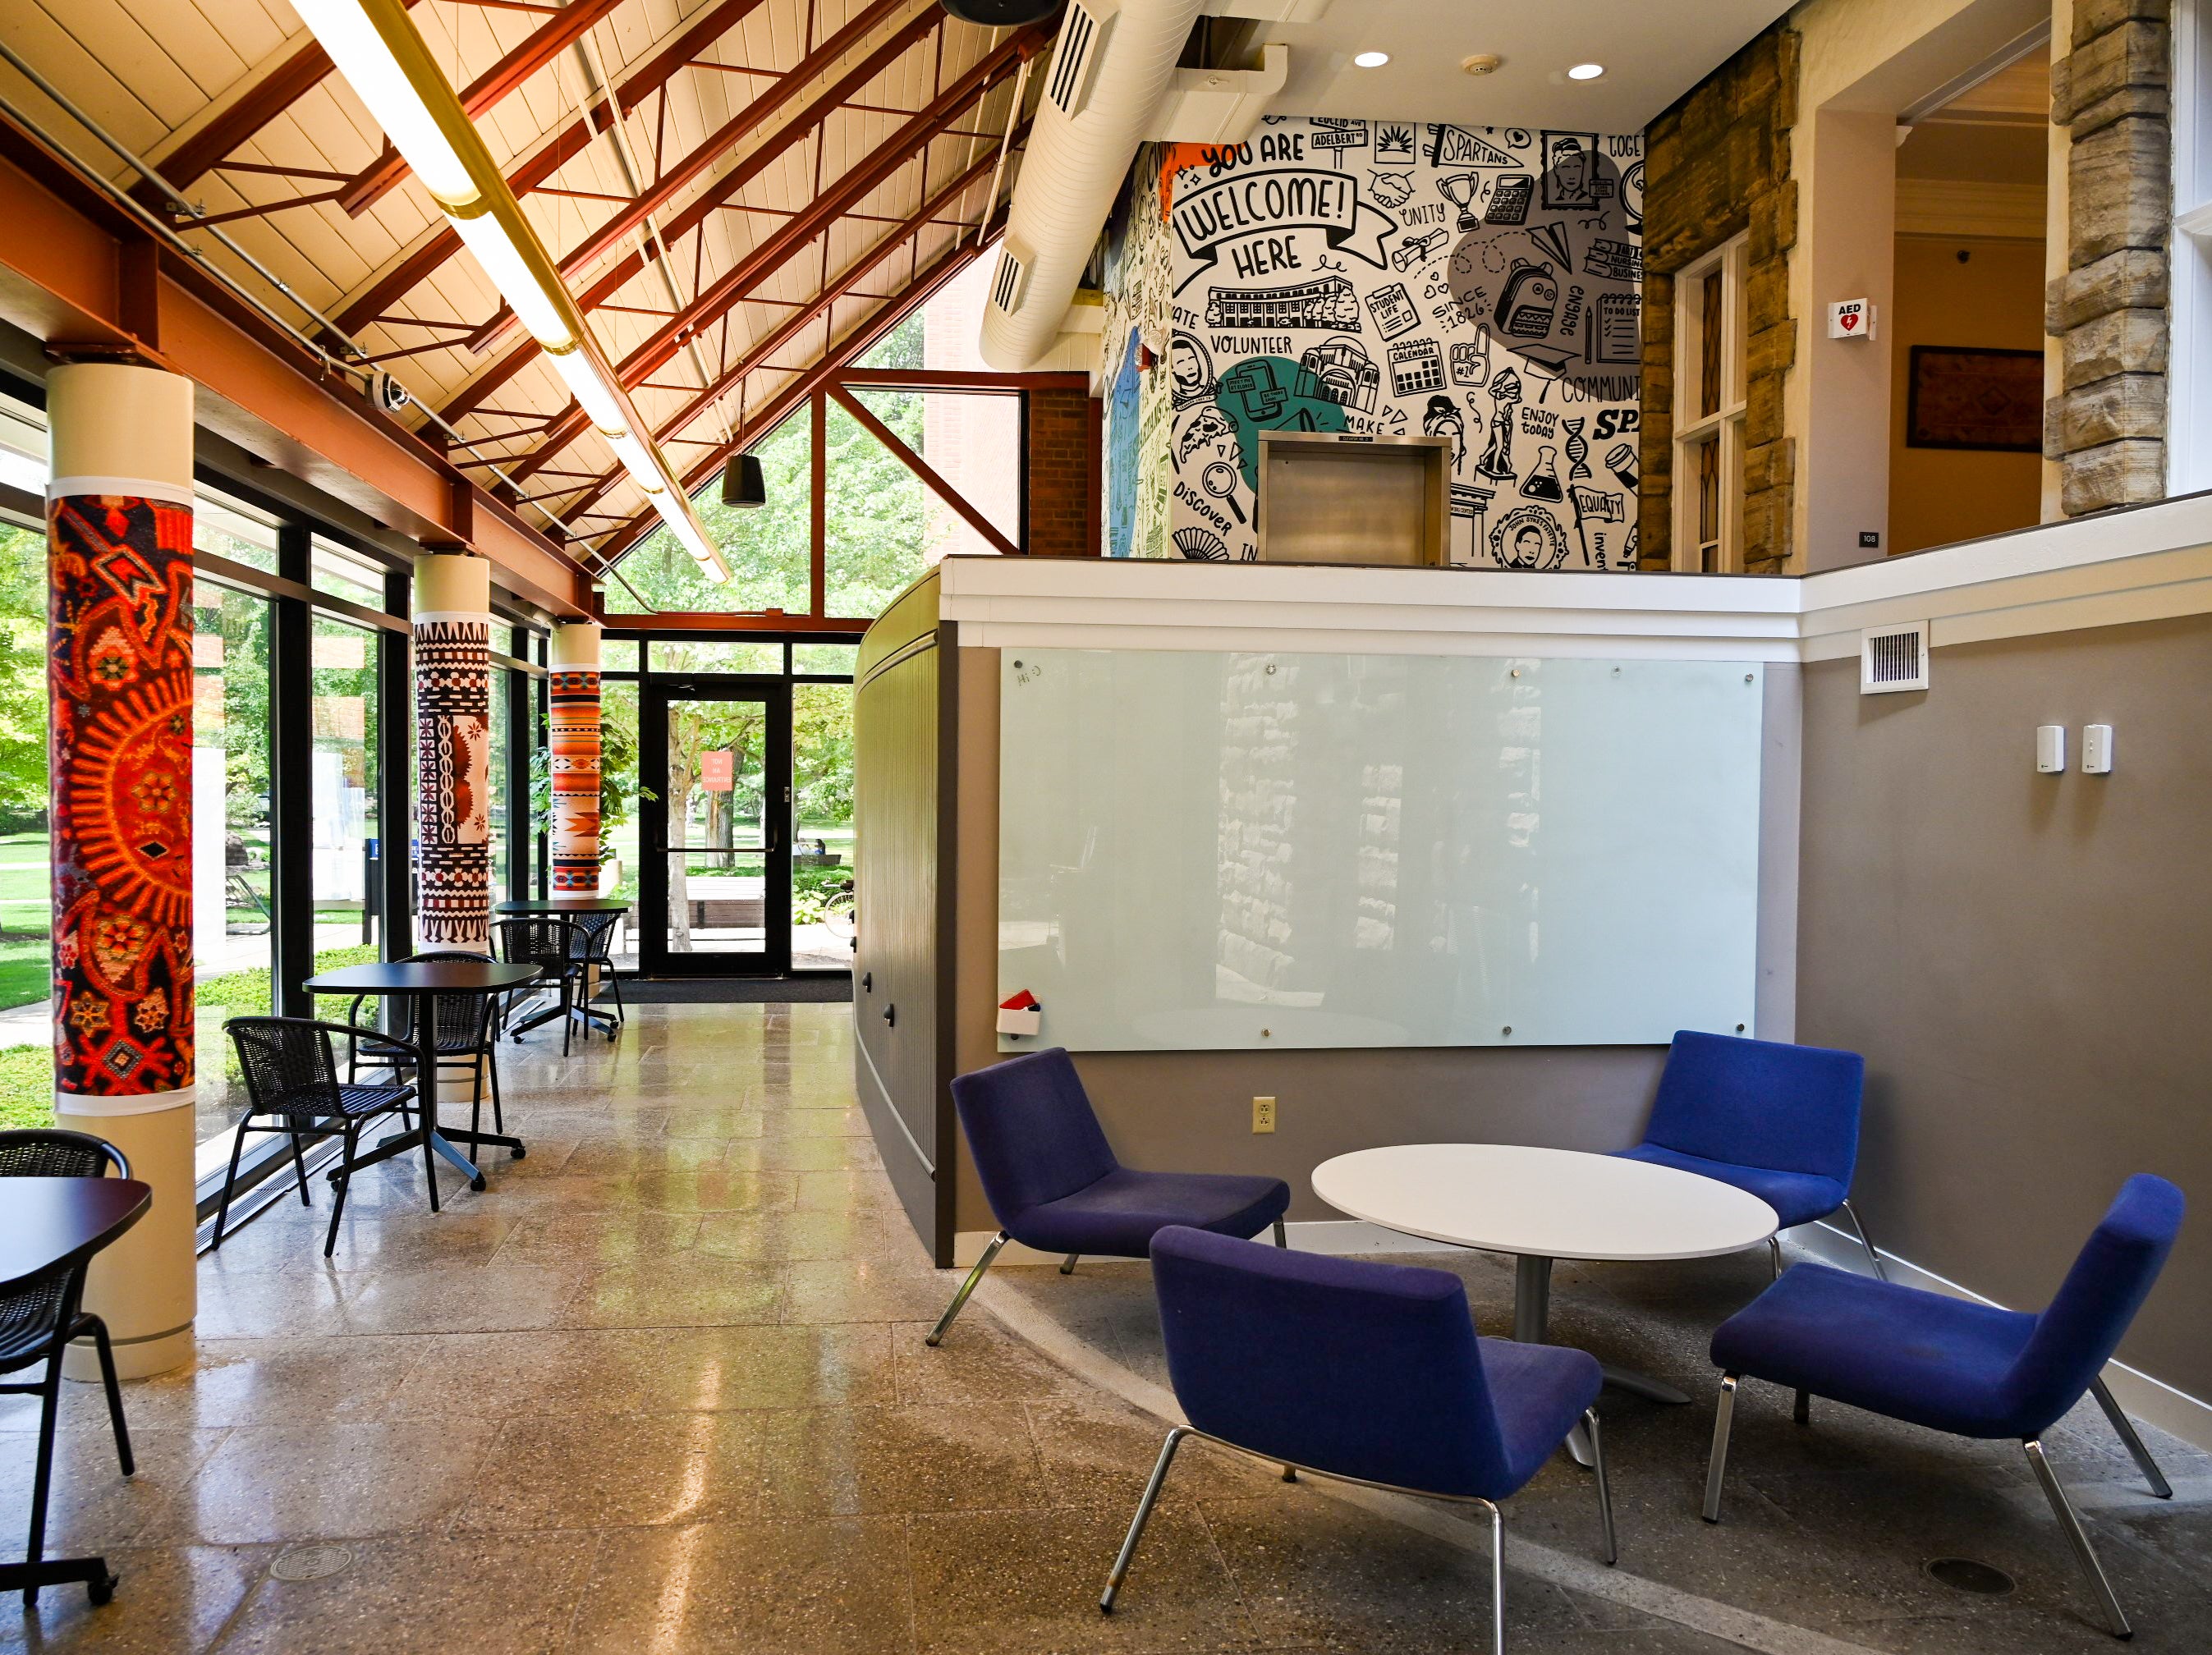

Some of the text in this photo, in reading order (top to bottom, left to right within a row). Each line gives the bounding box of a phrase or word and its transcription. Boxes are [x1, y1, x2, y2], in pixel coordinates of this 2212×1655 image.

[1318, 117, 1349, 128] EUCLID
[1315, 133, 1356, 147] ADELBERT
[1443, 130, 1508, 165] SPARTANS
[1607, 135, 1643, 158] TOGE
[1200, 140, 1254, 178] YOU
[1260, 133, 1305, 163] ARE
[1181, 177, 1345, 241] WELCOME!
[1398, 202, 1445, 227] UNITY
[1232, 235, 1302, 279] HERE
[1369, 289, 1405, 314] STUDENT
[1380, 304, 1399, 319] LIFE
[1432, 286, 1487, 319] SINCE
[1604, 306, 1640, 317] TO DO LIST
[1838, 303, 1861, 315] AED
[1446, 303, 1485, 329] 1826
[1210, 334, 1292, 355] VOLUNTEER
[1393, 346, 1434, 361] CALENDAR
[1456, 365, 1469, 378] #1
[1343, 415, 1385, 434] MAKE
[1521, 406, 1560, 428] ENJOY
[1592, 410, 1641, 440] SP
[1508, 517, 1525, 531] JOHN
[1526, 516, 1544, 526] SYKES
